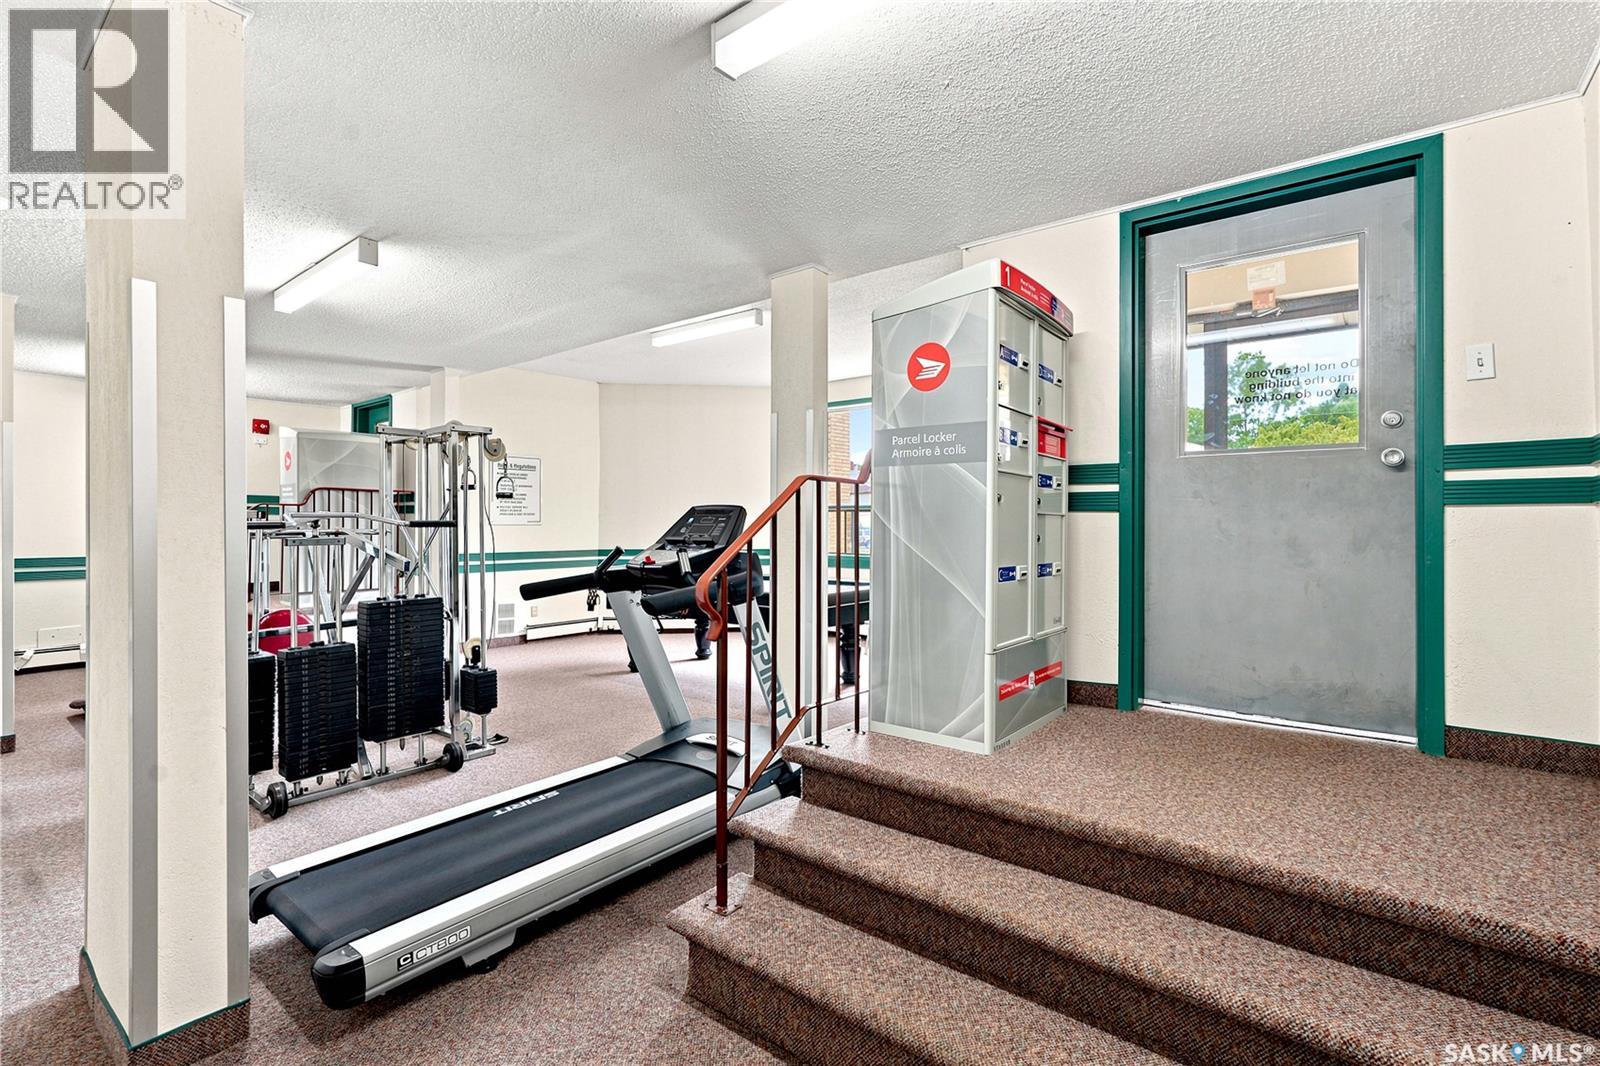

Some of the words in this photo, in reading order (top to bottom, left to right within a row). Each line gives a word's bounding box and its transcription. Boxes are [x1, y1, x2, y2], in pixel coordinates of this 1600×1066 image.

[1005, 266, 1011, 287] 1
[892, 433, 920, 445] Parcel
[923, 432, 957, 443] Locker
[891, 446, 932, 458] Armoire
[934, 446, 940, 456] à
[943, 444, 967, 455] colis
[492, 790, 560, 817] SPIRIT
[415, 928, 469, 960] CT800
